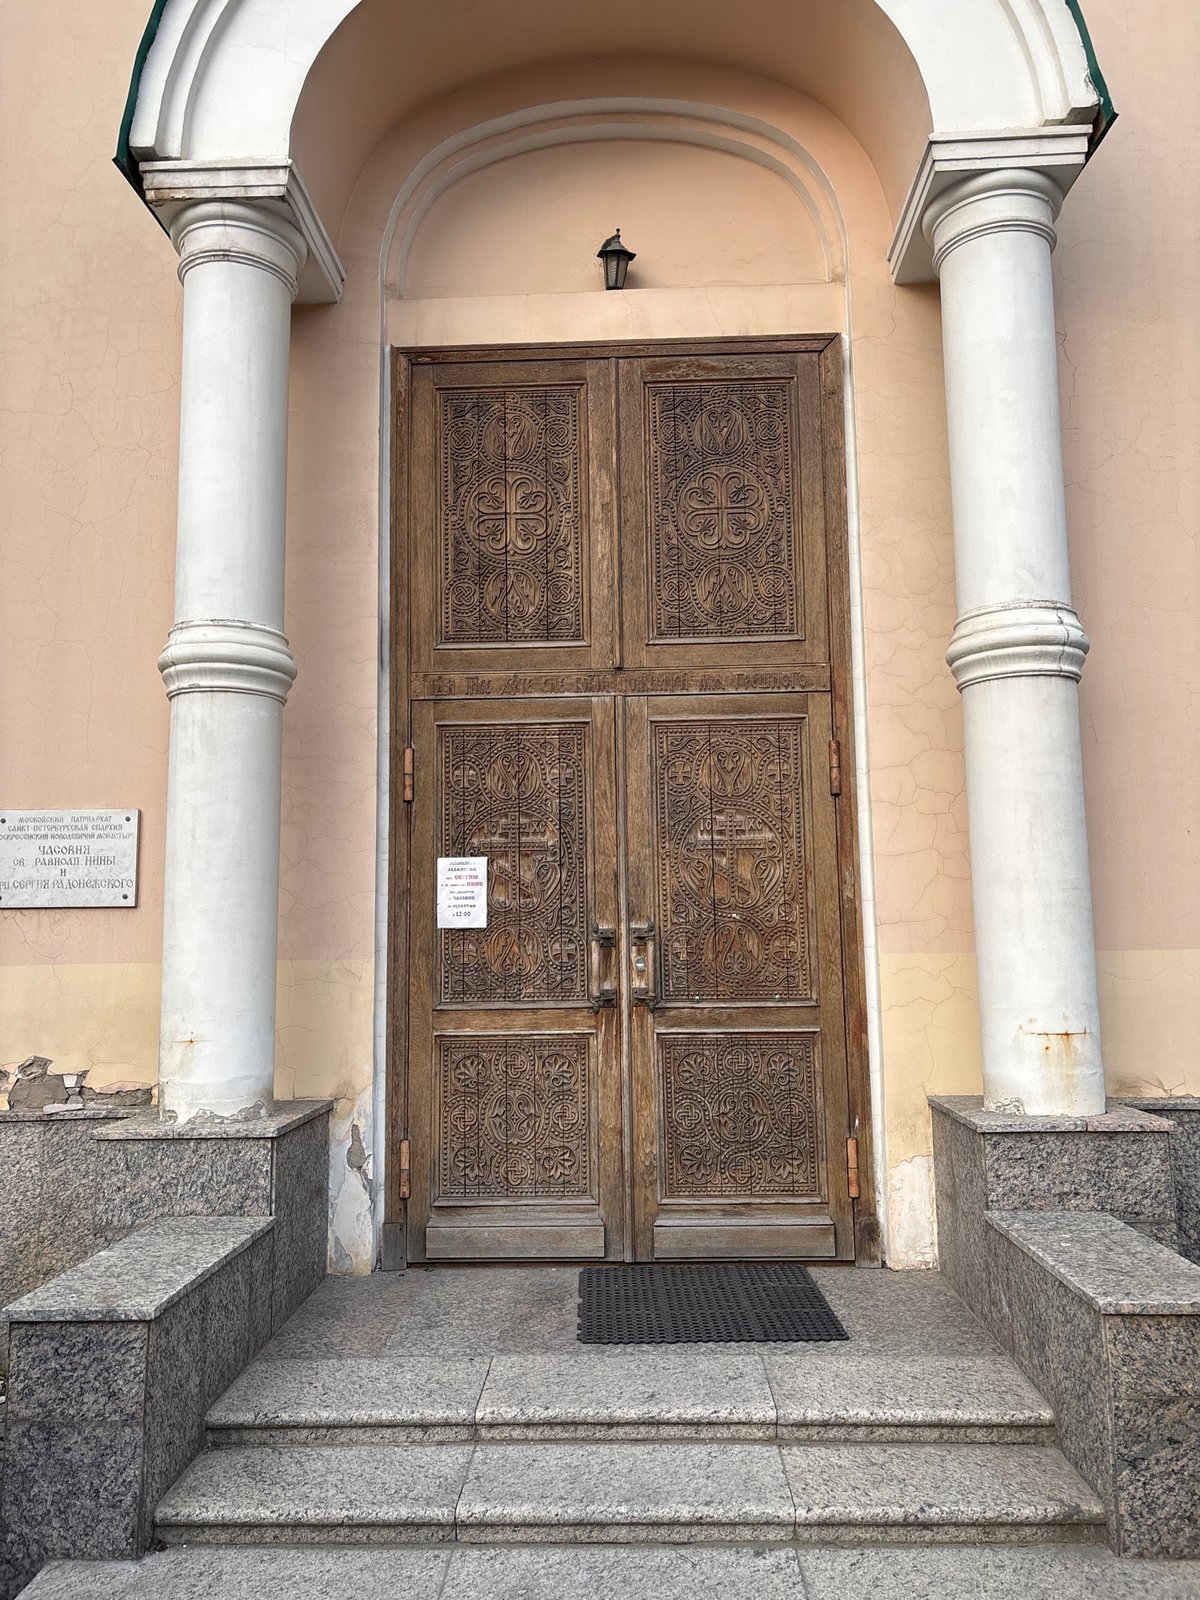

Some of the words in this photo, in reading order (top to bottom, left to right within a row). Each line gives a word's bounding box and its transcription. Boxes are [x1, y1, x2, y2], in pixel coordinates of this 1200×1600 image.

[71, 815, 112, 823] ПАТРИАРХАТ
[91, 823, 123, 831] ЕПАРХИЯ
[38, 845, 90, 855] ЧАСОВНЯ
[35, 857, 83, 866] РАВНОАП.
[85, 856, 116, 866] НИНЫ
[60, 868, 67, 877] И
[12, 879, 50, 889] СЕРГИЯ
[52, 878, 134, 890] РАДОНЕЖСКОГО
